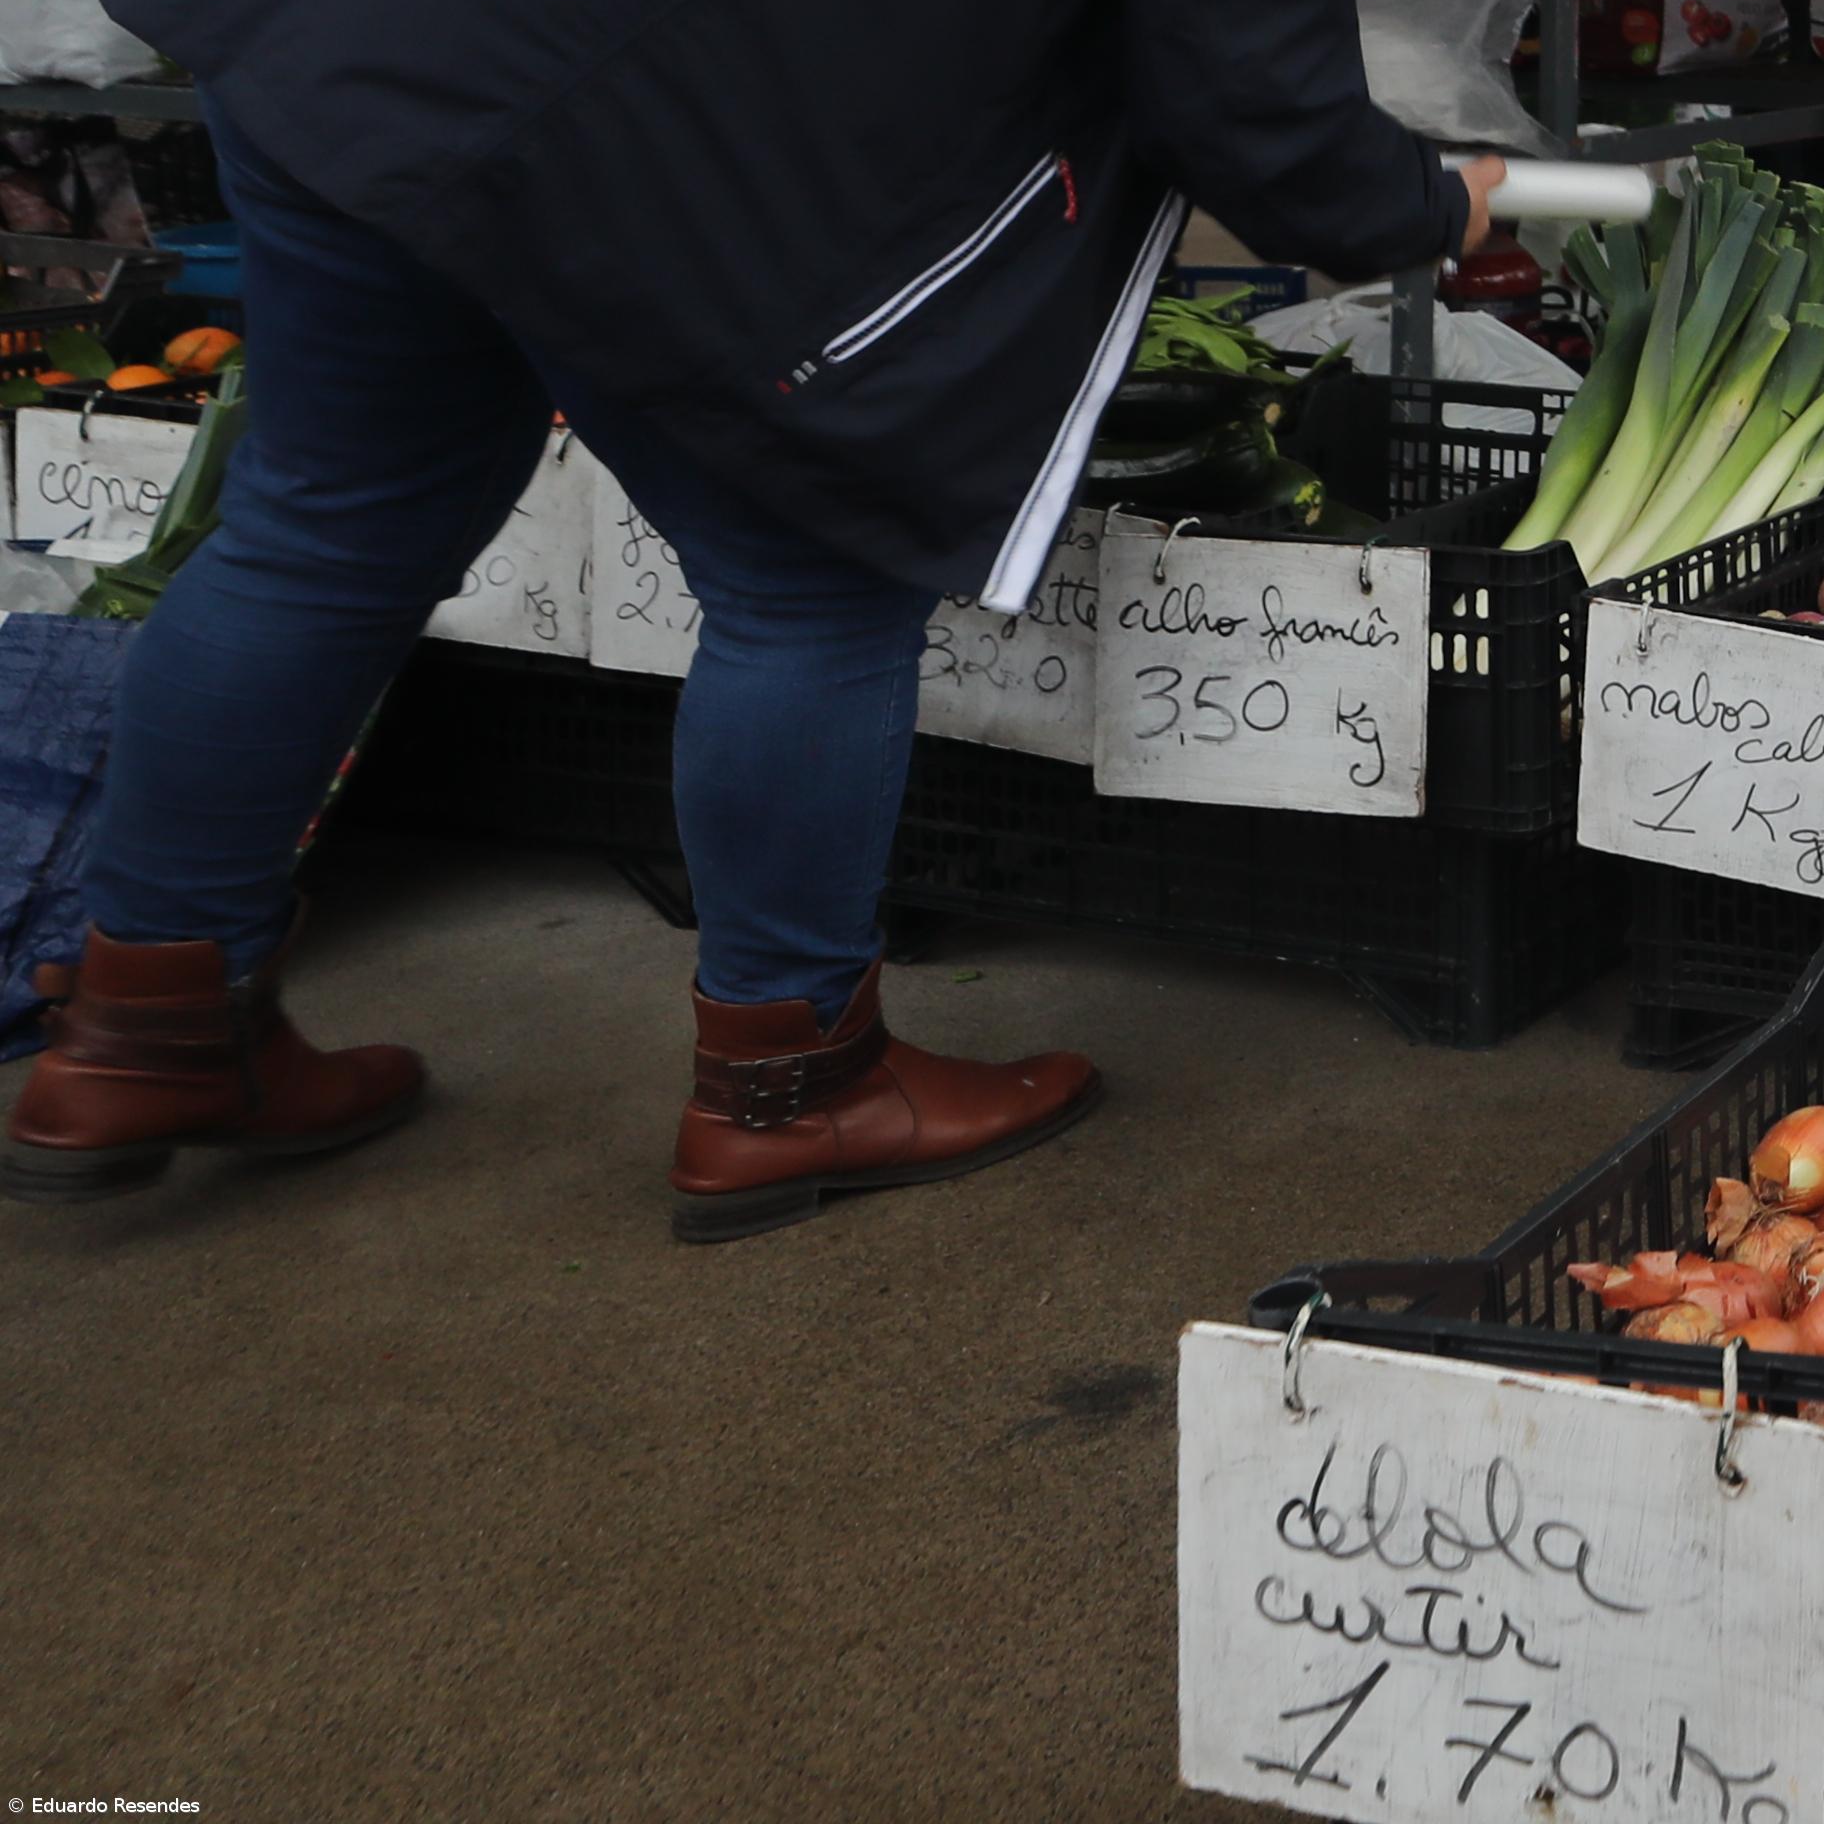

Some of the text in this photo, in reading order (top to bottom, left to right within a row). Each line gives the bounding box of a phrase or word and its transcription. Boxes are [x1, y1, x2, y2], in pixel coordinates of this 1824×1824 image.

[39, 461, 172, 516] ceno
[1119, 583, 1249, 638] alho
[1259, 584, 1400, 663] francês
[1133, 665, 1289, 747] 3,50
[1600, 671, 1770, 733] nabos
[1254, 1574, 1562, 1671] curtir
